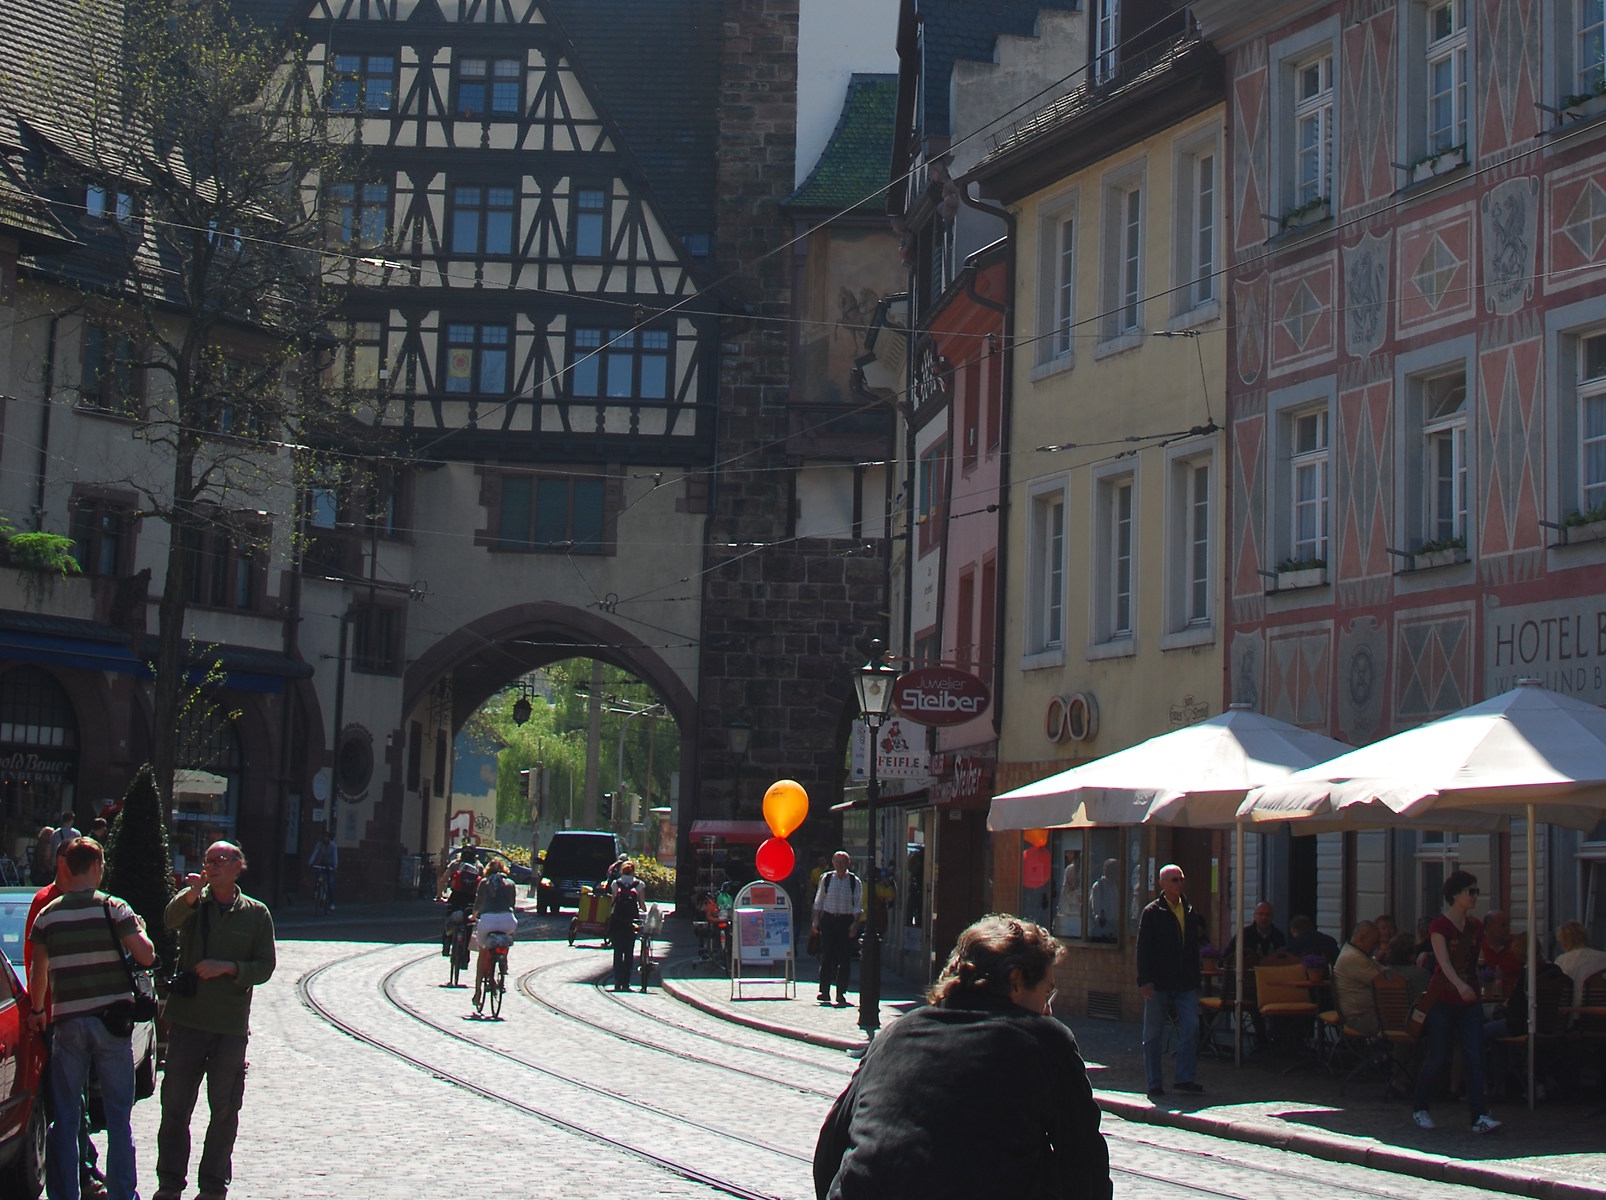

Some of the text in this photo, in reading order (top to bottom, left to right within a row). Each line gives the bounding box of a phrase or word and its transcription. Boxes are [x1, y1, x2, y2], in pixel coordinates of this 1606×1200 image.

[1496, 615, 1589, 667] HOTEL
[916, 675, 967, 690] Juwelier
[1545, 667, 1586, 692] UND
[901, 688, 984, 713] Steiber
[25, 753, 72, 773] Bauer
[876, 756, 920, 768] FEIFLE
[952, 754, 982, 798] Steiber
